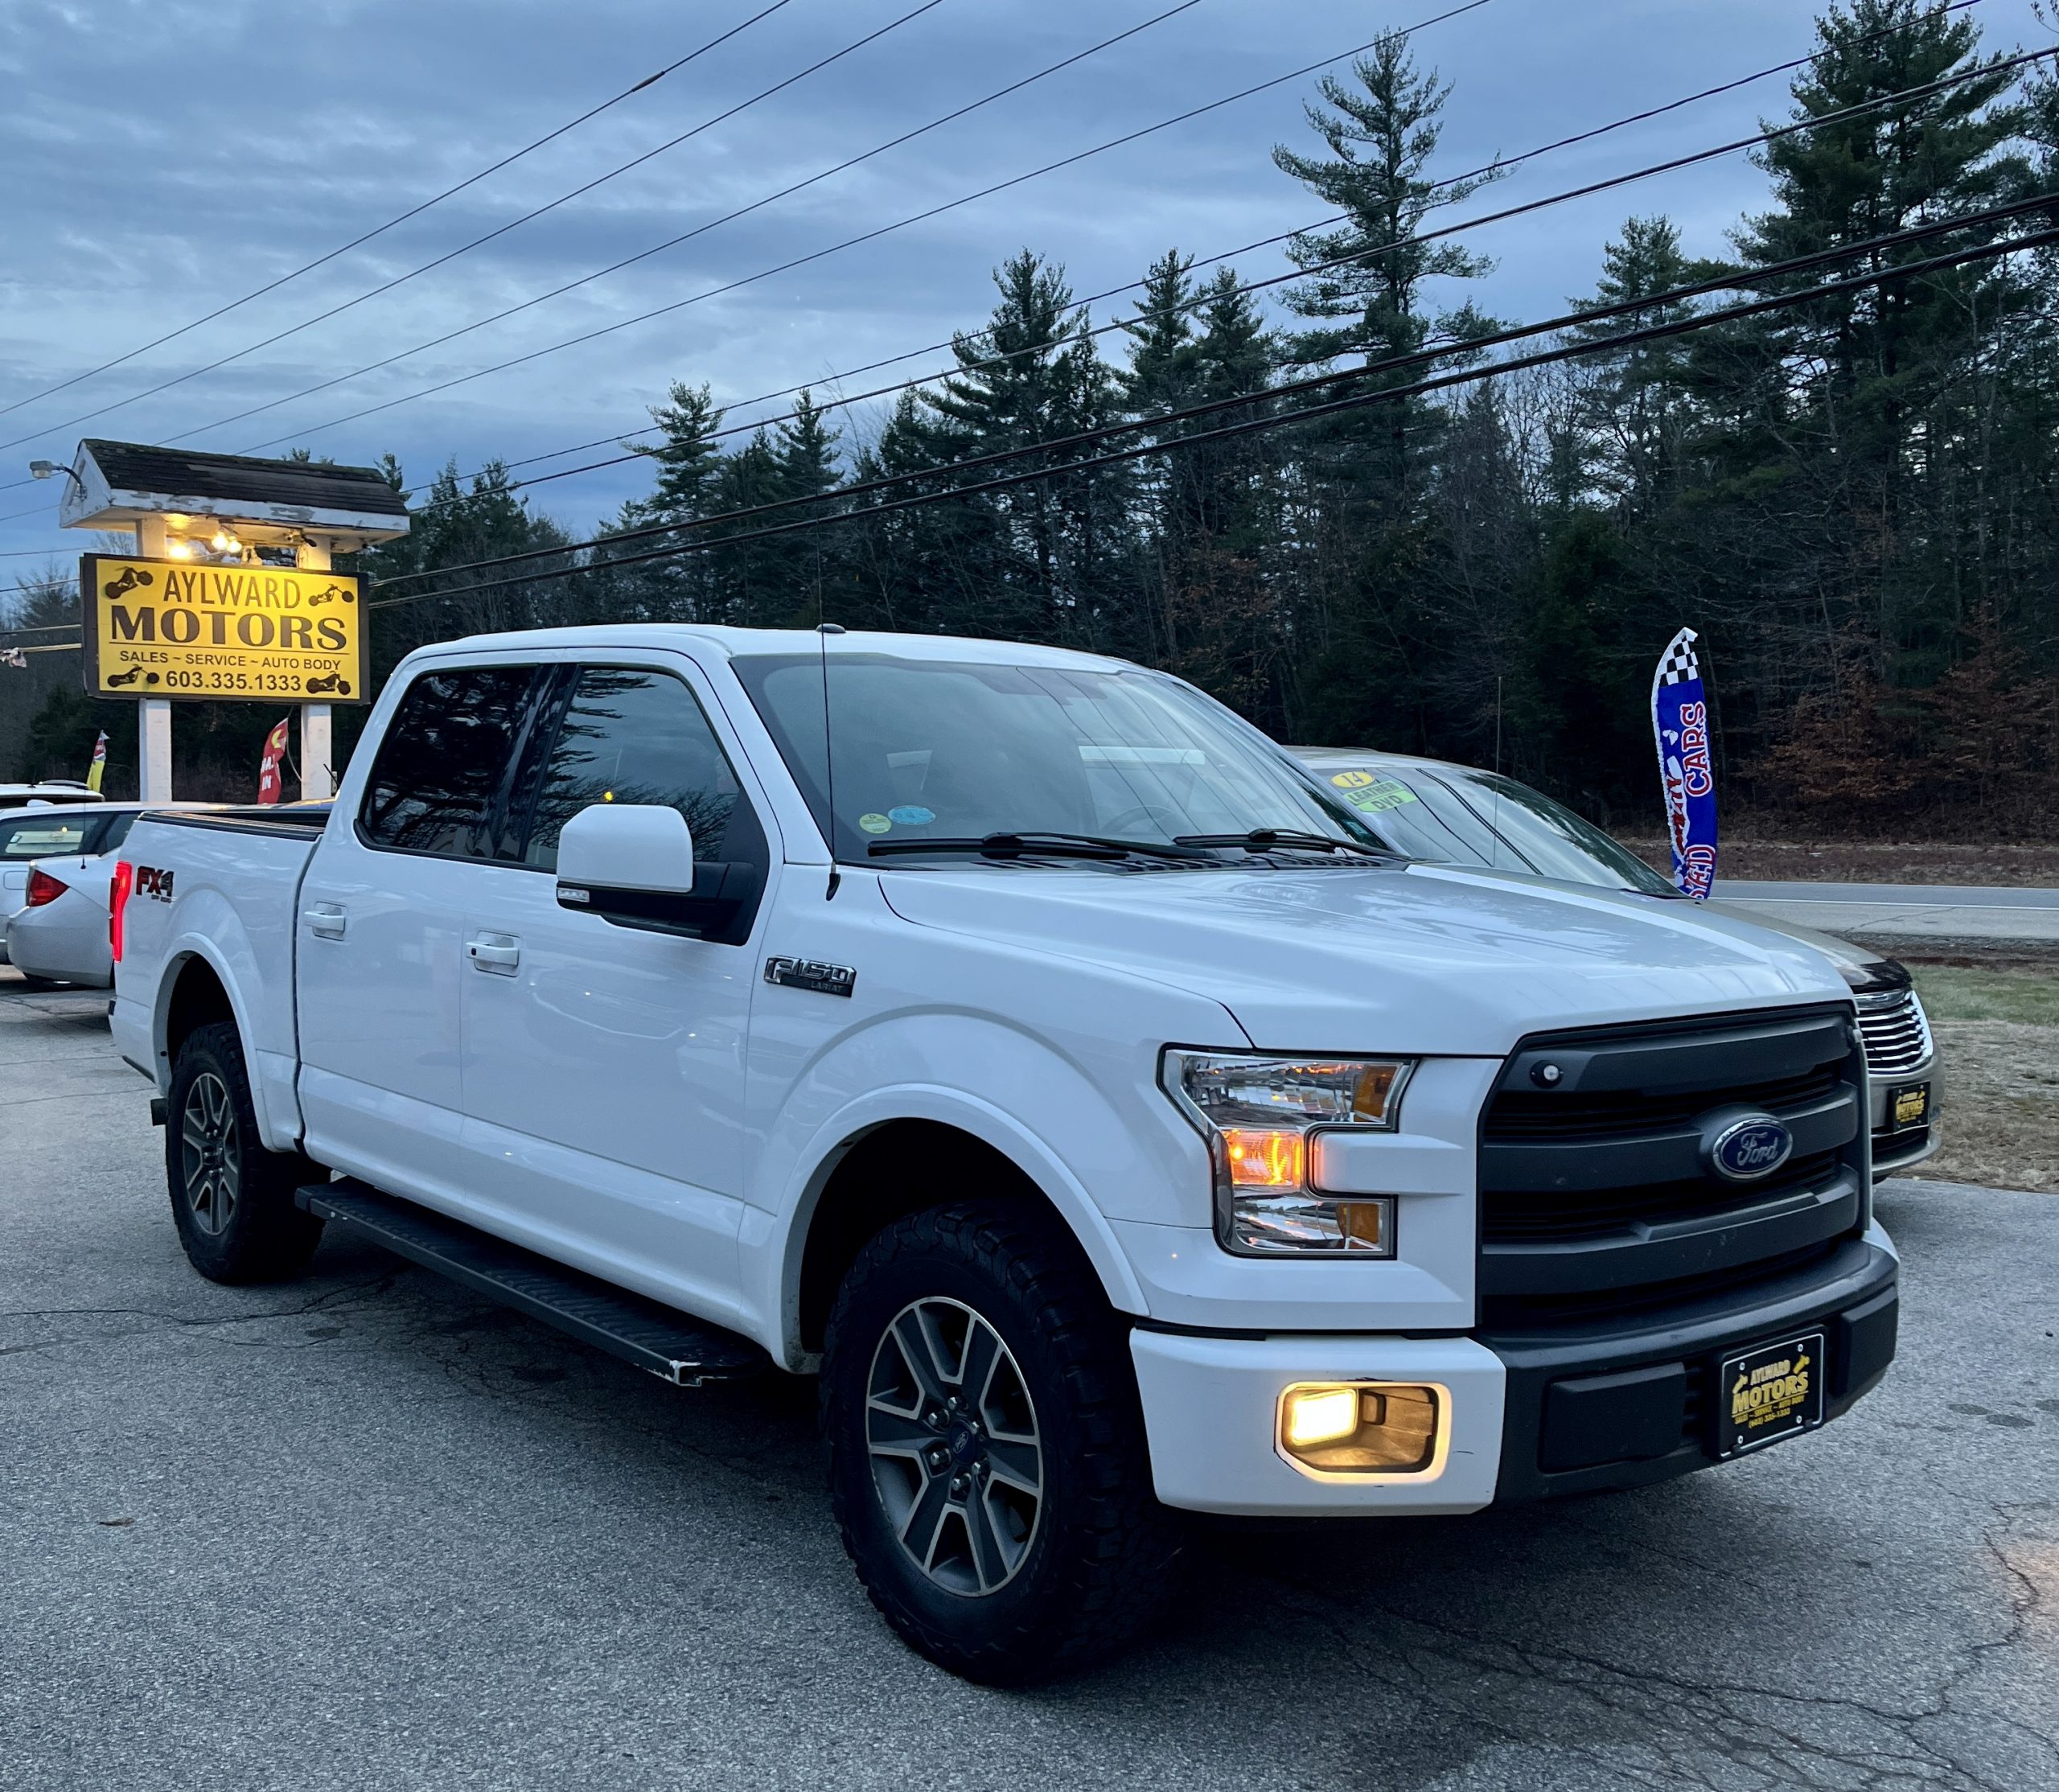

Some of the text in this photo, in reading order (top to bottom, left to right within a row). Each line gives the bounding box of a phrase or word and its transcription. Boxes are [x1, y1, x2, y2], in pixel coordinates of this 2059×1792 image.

[163, 569, 301, 609] AYLWARD
[111, 605, 347, 651] MOTORS
[120, 651, 168, 664] SALES
[185, 653, 246, 667] SERVICE
[262, 656, 298, 669] AUTO
[303, 658, 341, 671] BODY
[166, 670, 302, 692] 603.335.1333
[1680, 701, 1713, 797] CARS
[1341, 772, 1364, 786] 14
[1346, 782, 1399, 802] LEATHER
[1370, 795, 1403, 811] DVD
[136, 865, 174, 898] FX4
[811, 980, 844, 993] LARIAT
[1737, 1132, 1778, 1166] Ford
[1732, 1371, 1809, 1414] MOTORS
